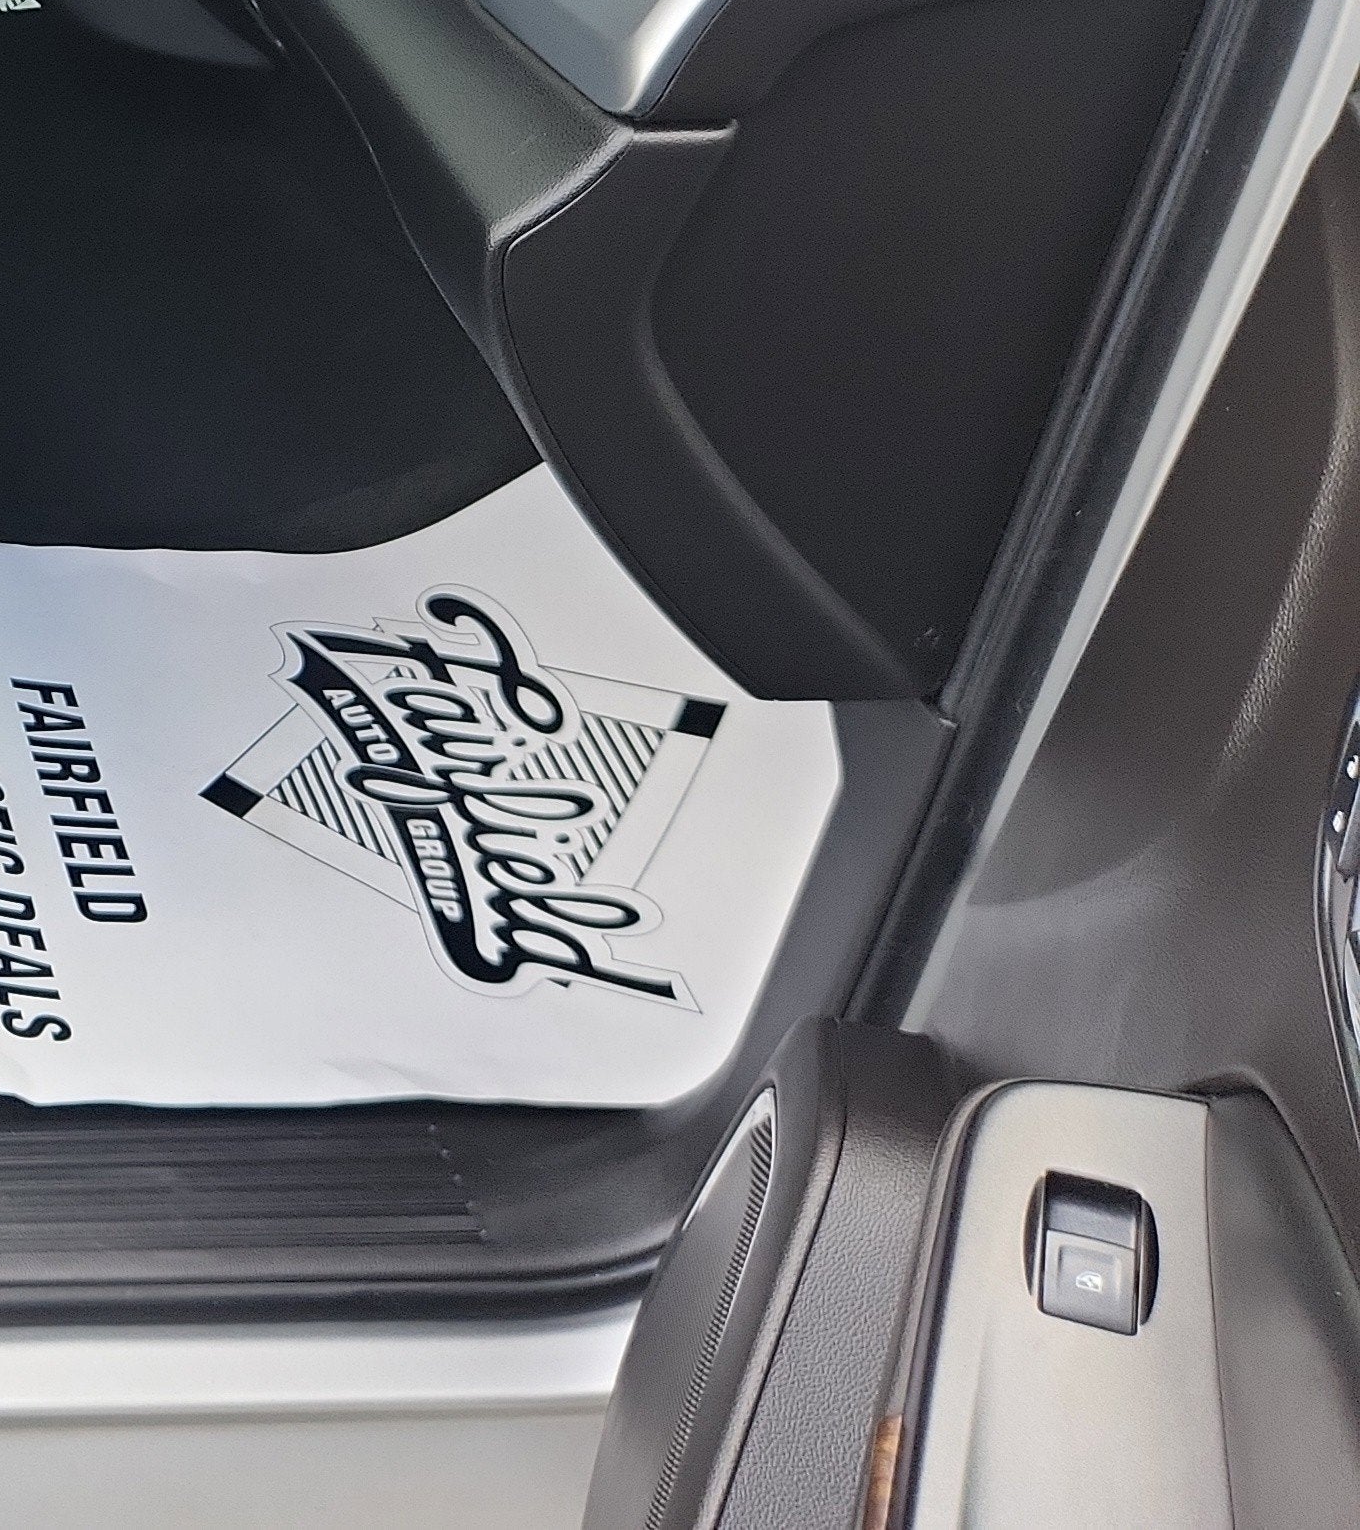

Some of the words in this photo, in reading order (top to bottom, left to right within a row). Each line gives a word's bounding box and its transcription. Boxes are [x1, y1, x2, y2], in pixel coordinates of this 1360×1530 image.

[10, 677, 148, 923] FAIRFIELD
[303, 593, 678, 1000] Fairfield
[321, 688, 403, 765] AUTO
[403, 816, 465, 923] GROUP
